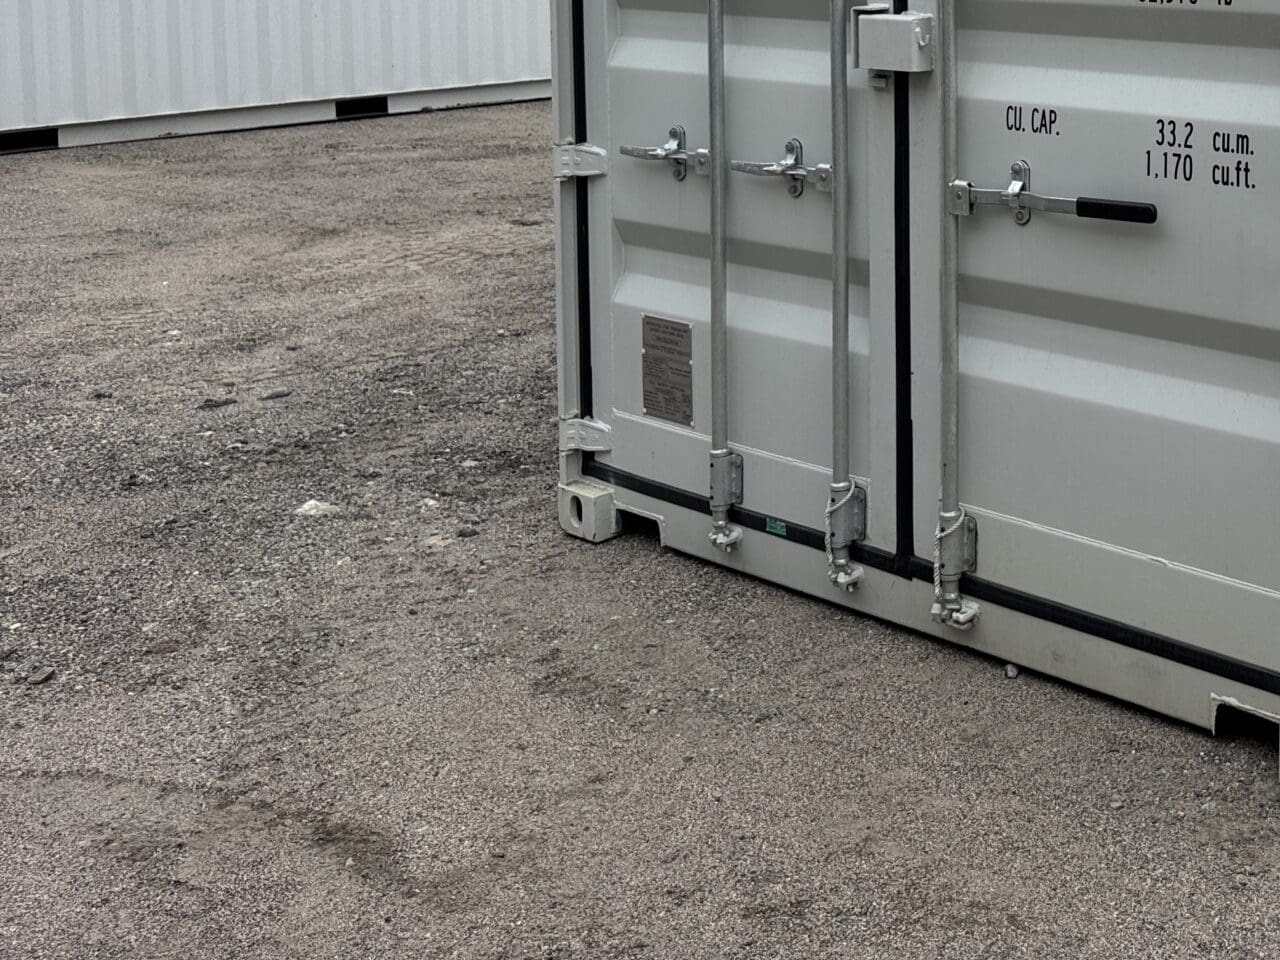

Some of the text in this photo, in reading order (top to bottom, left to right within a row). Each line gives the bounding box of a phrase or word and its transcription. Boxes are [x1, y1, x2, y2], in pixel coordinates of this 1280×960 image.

[1006, 105, 1254, 155] CU. CAP. 33.2 cu.m.
[1146, 150, 1256, 189] 1,170 cu.ft.
